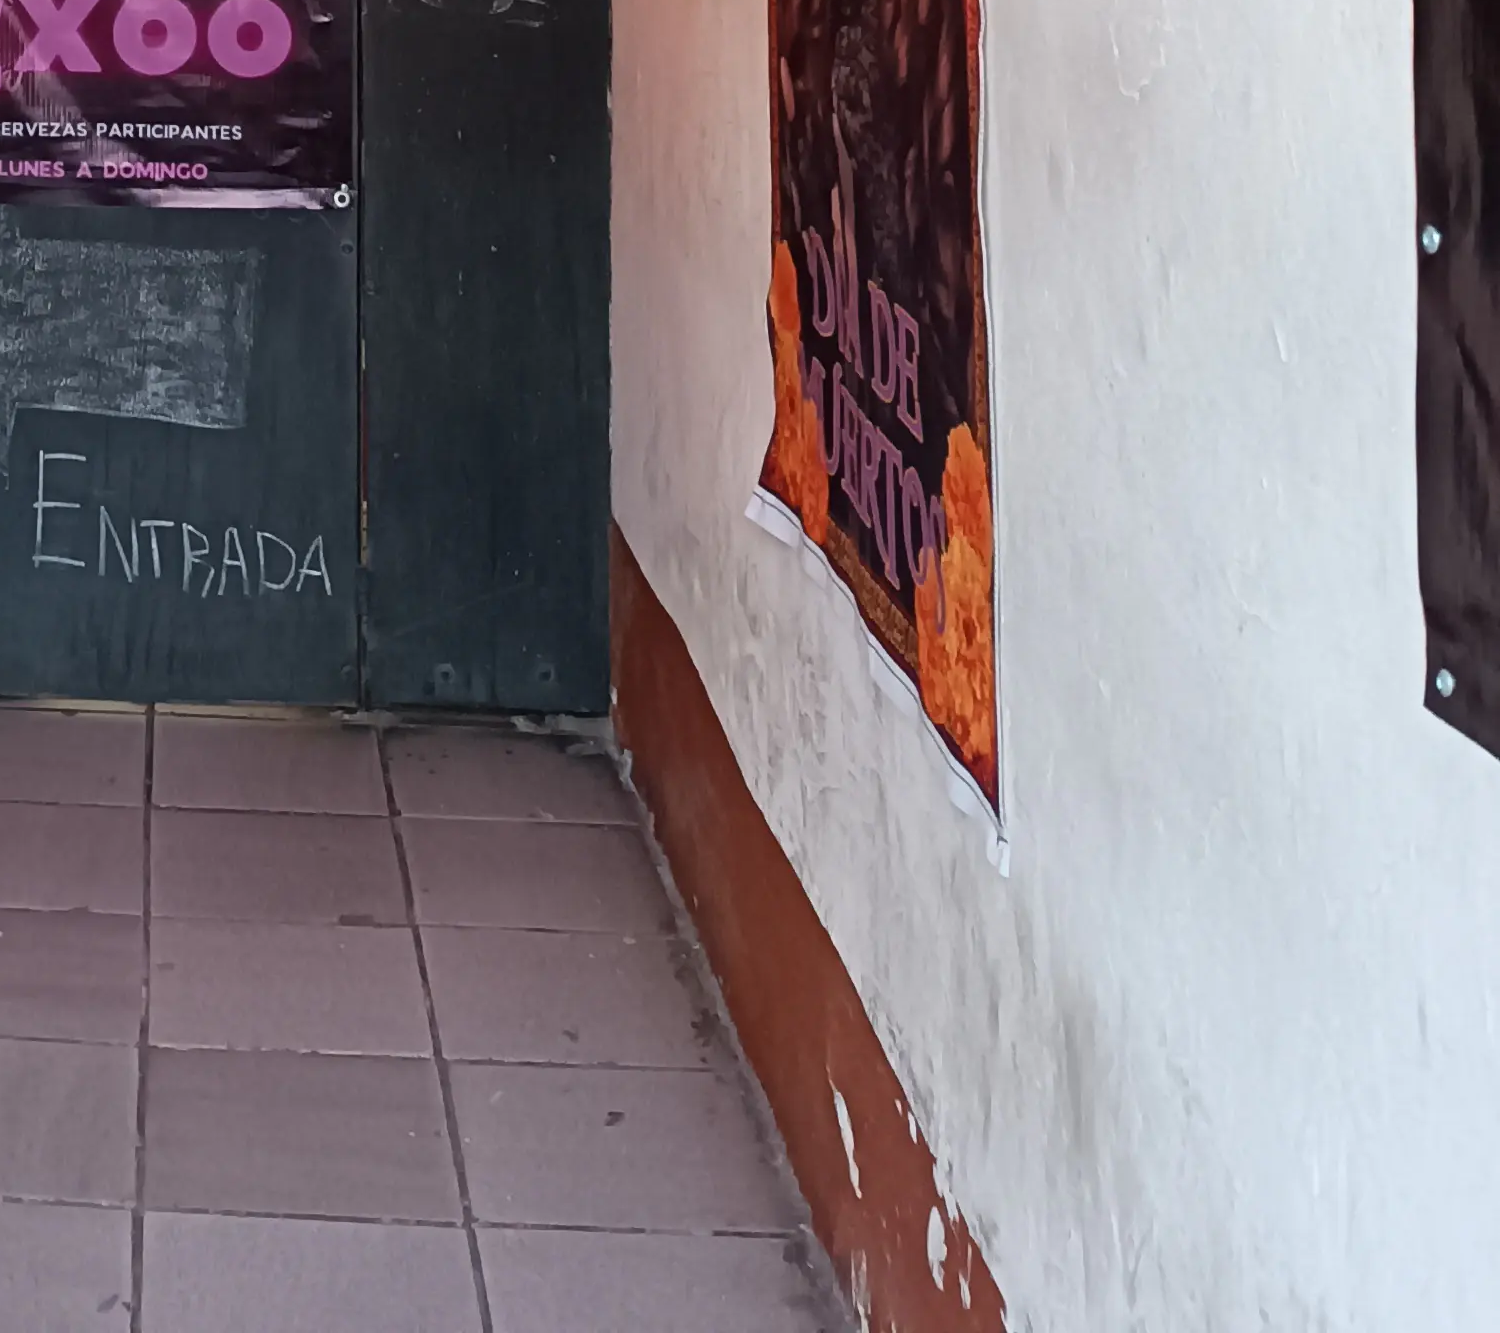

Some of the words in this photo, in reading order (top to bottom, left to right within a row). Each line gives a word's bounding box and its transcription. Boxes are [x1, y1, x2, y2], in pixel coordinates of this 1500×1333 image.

[76, 160, 93, 179] A
[103, 161, 209, 182] DOMINGO
[96, 123, 243, 142] PARTICIPANTES
[868, 278, 924, 444] DE
[32, 449, 333, 599] ENTRADA
